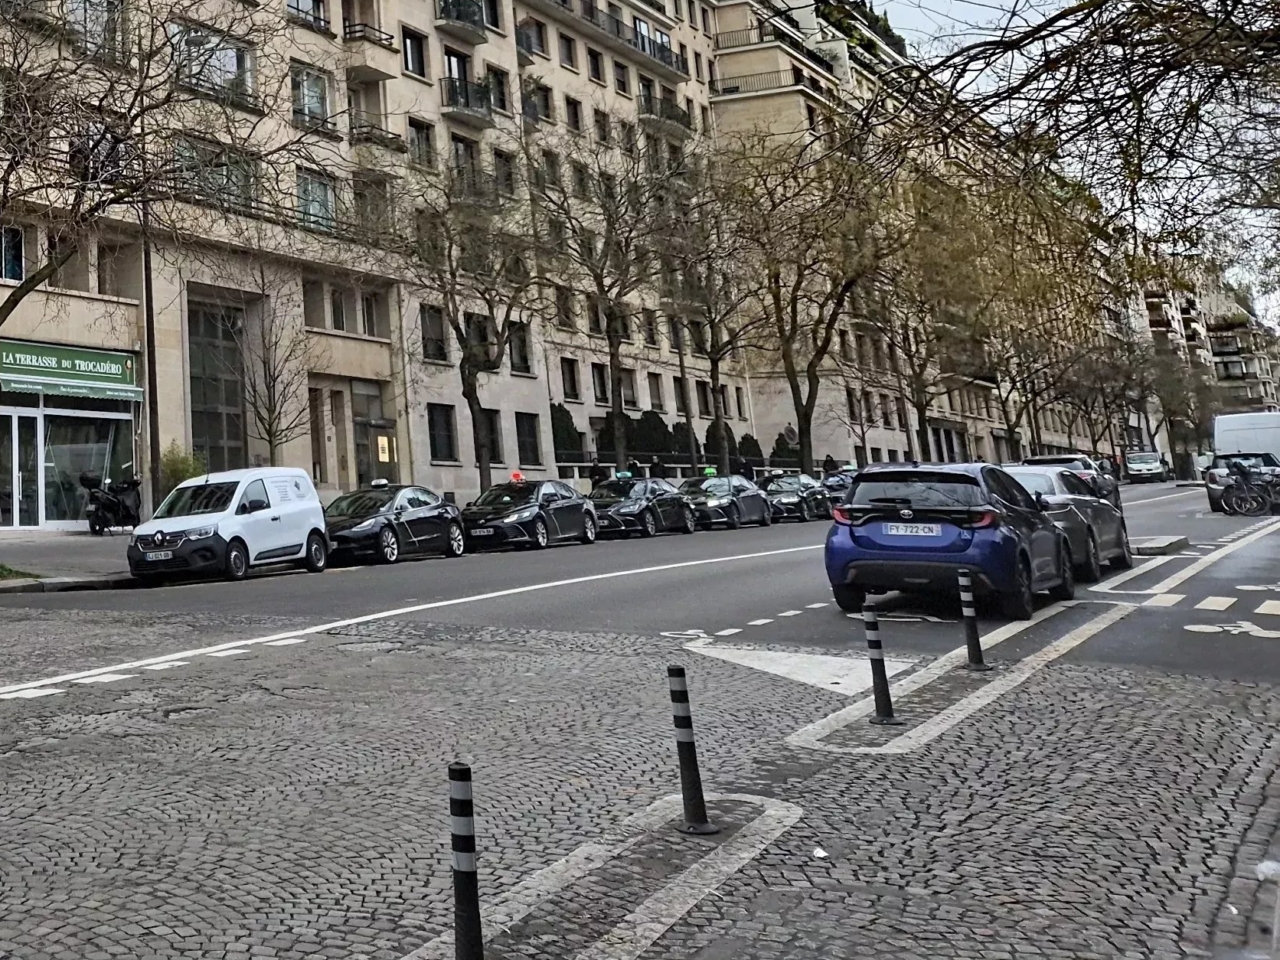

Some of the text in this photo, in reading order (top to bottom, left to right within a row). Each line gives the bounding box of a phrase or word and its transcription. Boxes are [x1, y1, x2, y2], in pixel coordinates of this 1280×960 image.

[2, 352, 122, 375] LA TERRASSE DU TROCADÉRO
[889, 524, 934, 534] FY-722-CN
